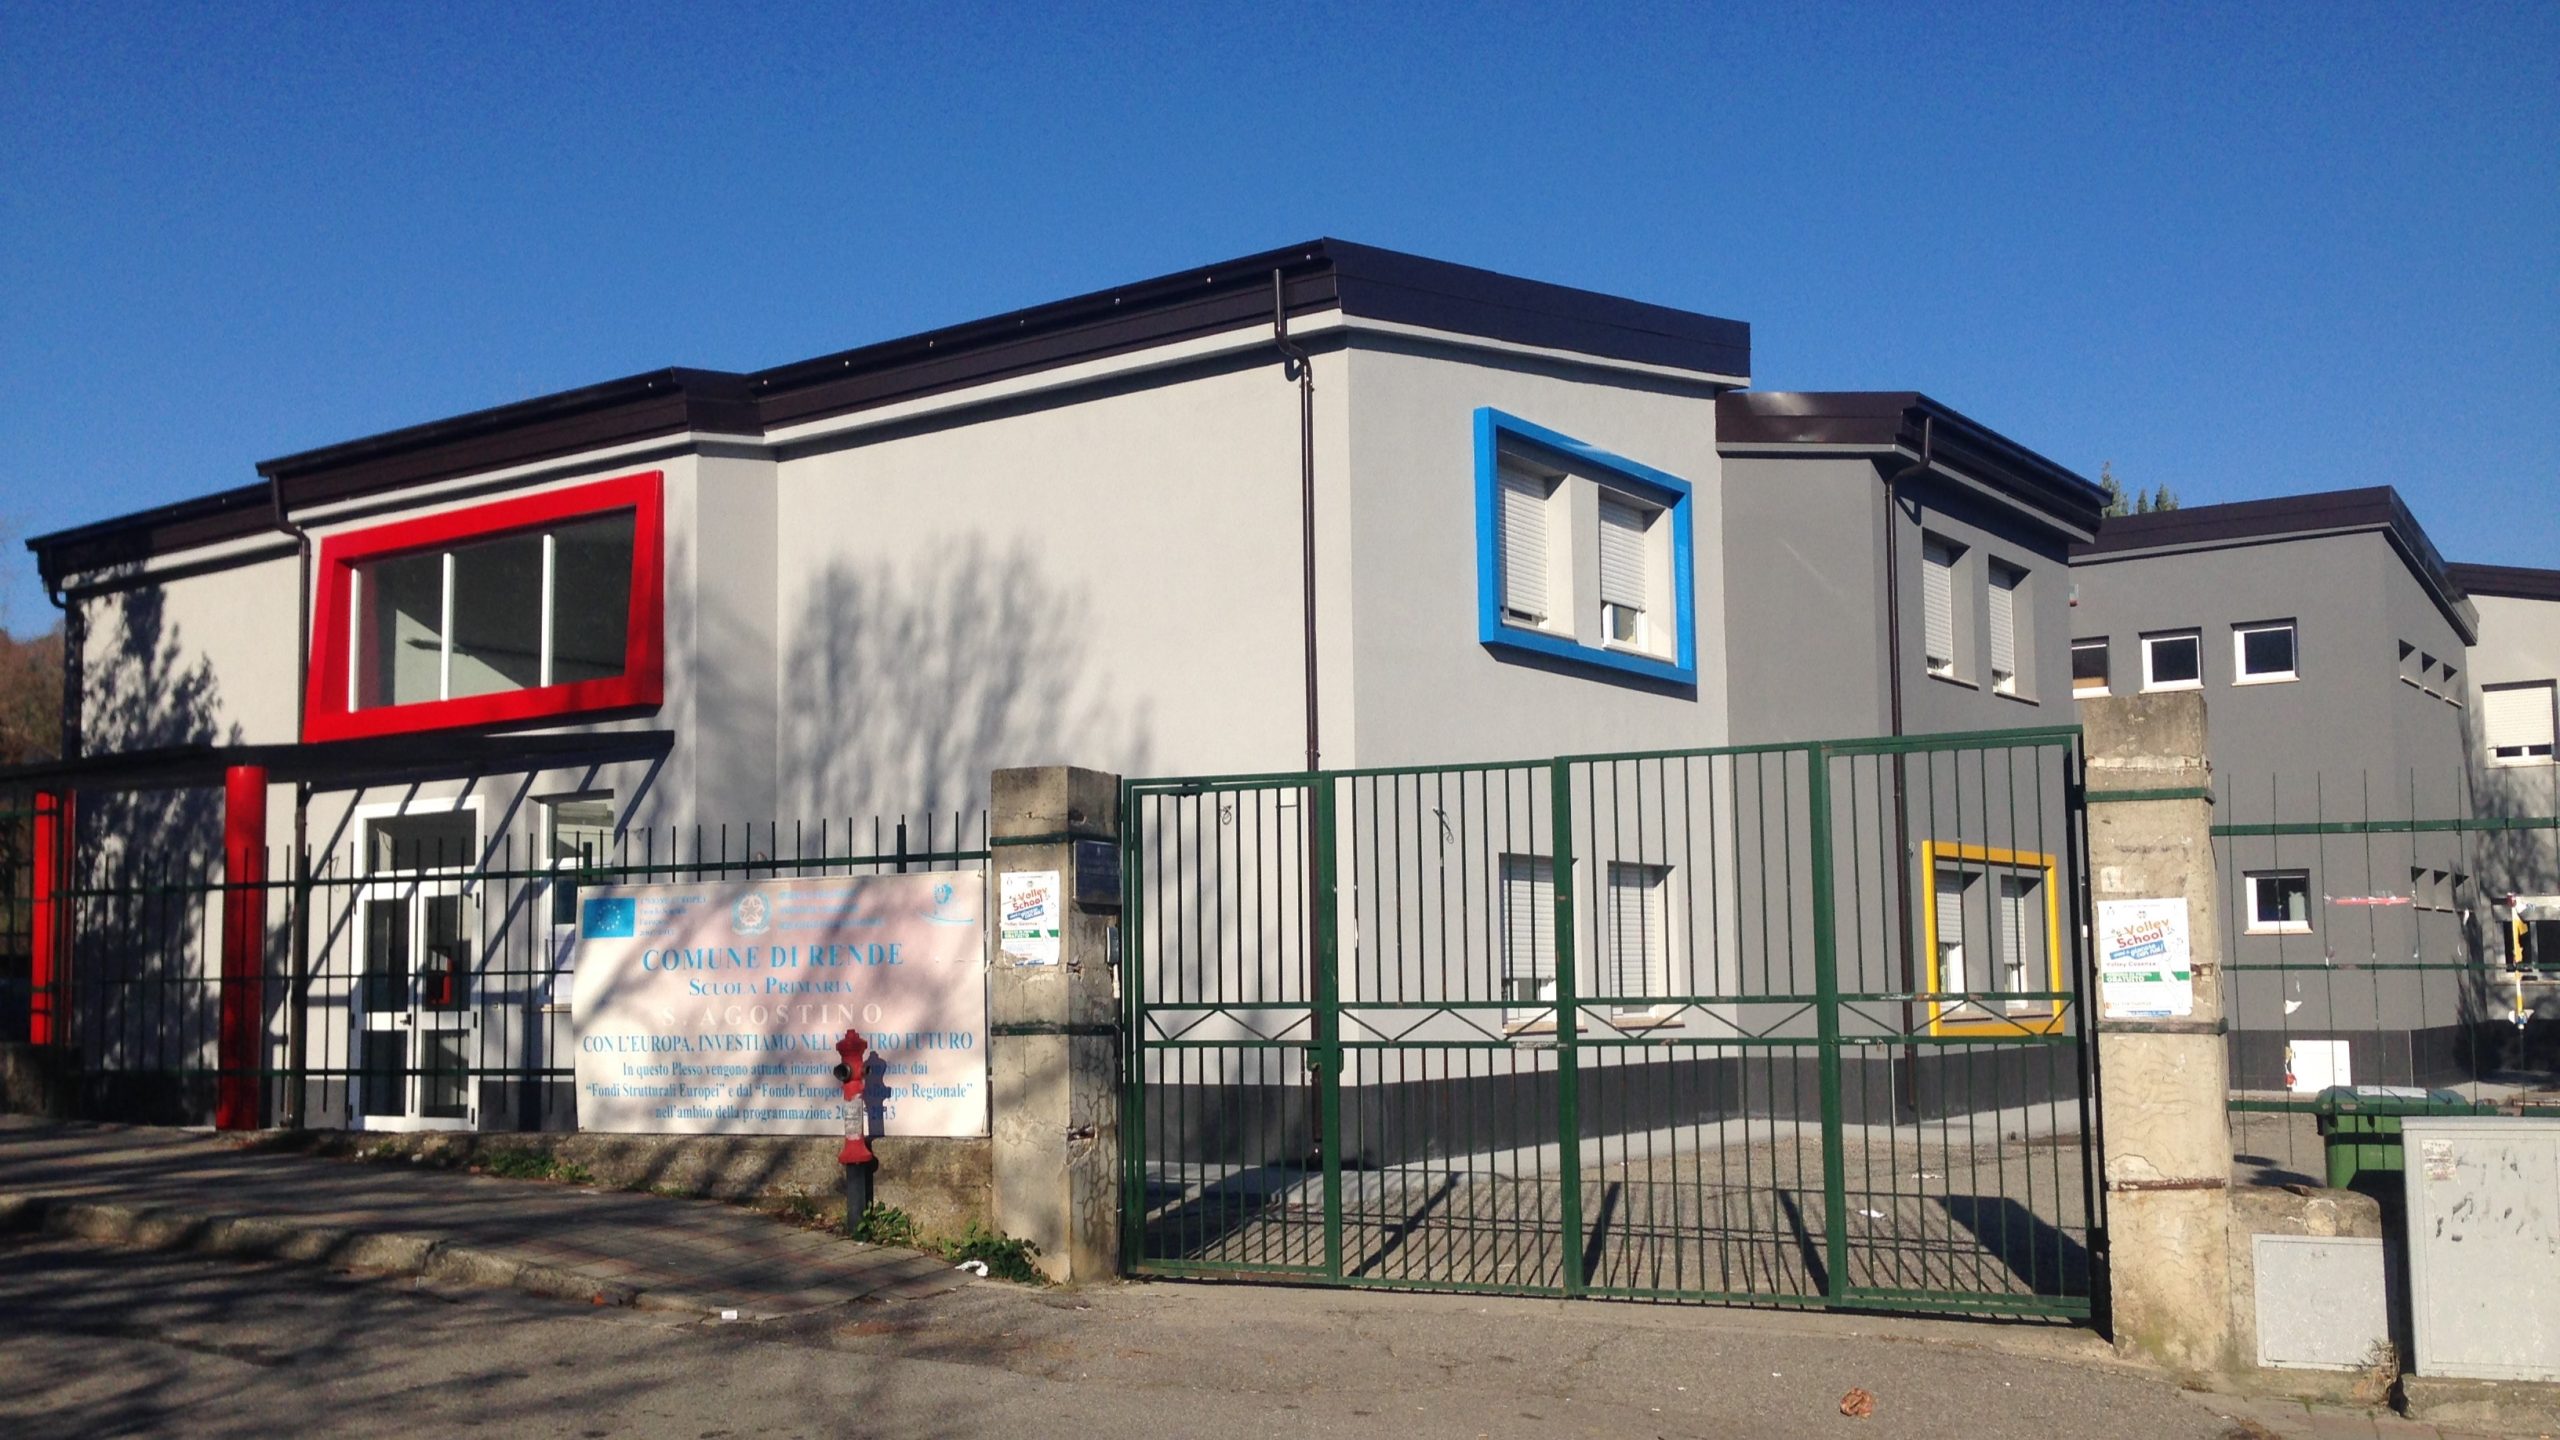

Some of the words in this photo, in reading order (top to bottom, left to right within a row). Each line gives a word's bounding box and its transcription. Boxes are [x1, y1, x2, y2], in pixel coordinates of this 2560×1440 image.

[1012, 894, 1043, 912] School
[1018, 887, 1048, 902] Volley
[2124, 918, 2169, 936] Volley
[2116, 929, 2164, 949] School
[642, 946, 760, 972] COMUNE
[771, 945, 798, 968] DI
[809, 943, 904, 967] RENDE
[662, 1006, 688, 1027] S.
[701, 1003, 882, 1027] AGOSTINO
[583, 1035, 613, 1053] CON
[699, 1034, 796, 1052] INVESTIAMO
[801, 1034, 832, 1051] NEL
[905, 1032, 973, 1050] FUTURO
[623, 1062, 634, 1076] In
[636, 1064, 669, 1080] questo
[672, 1062, 703, 1077] Plesso
[706, 1065, 748, 1079] vengono
[751, 1063, 787, 1077] attuate
[791, 1062, 833, 1076] iniziativ
[911, 1061, 928, 1075] dai
[623, 1083, 676, 1098] Strutturali
[728, 1087, 733, 1098] e
[736, 1083, 753, 1098] dal
[715, 1105, 739, 1120] della
[742, 1105, 832, 1123] programmazione
